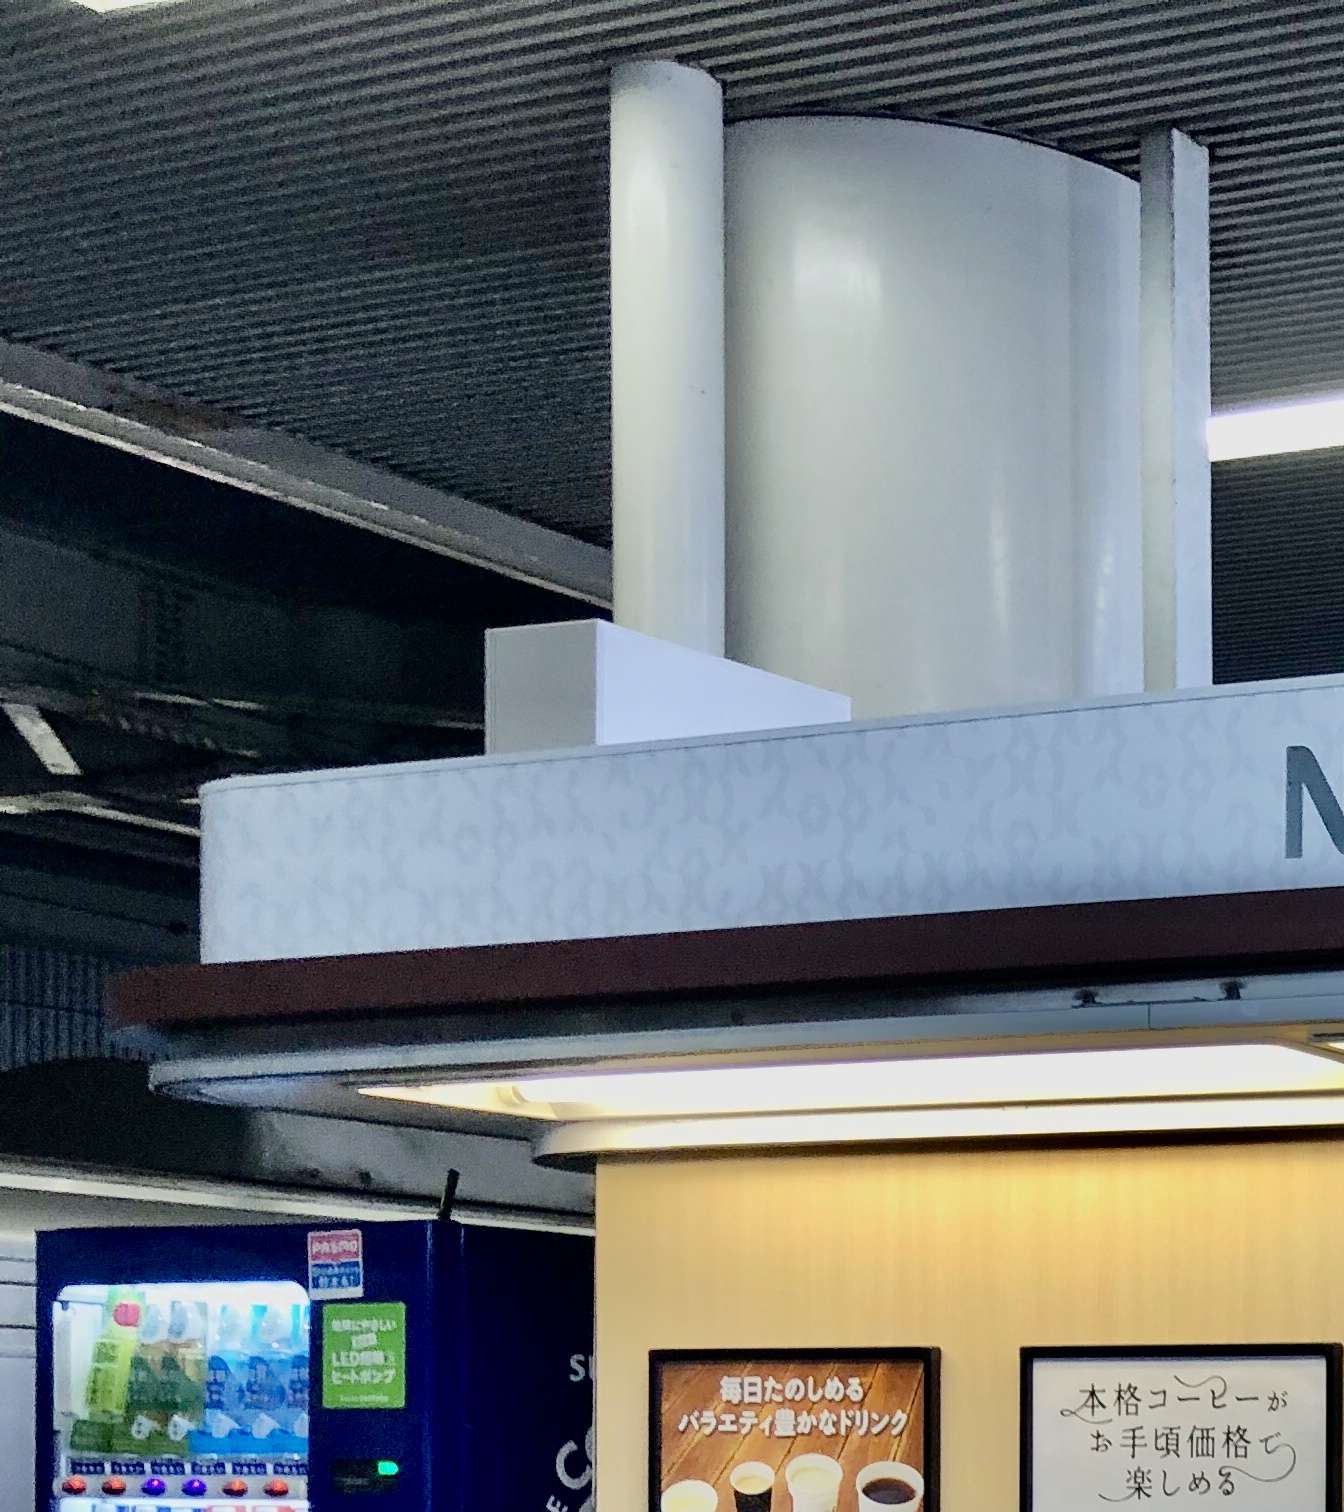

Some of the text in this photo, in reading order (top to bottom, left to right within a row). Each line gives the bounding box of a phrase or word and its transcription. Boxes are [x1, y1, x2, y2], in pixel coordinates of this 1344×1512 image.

[719, 1375, 865, 1405] 毎日たのしめる
[1072, 1379, 1288, 1417] 本格コーヒーが
[677, 1408, 908, 1437] バラエティ豊かなドリンク
[1090, 1424, 1286, 1462] お手頃価格で
[1122, 1465, 1236, 1500] 楽しめる
